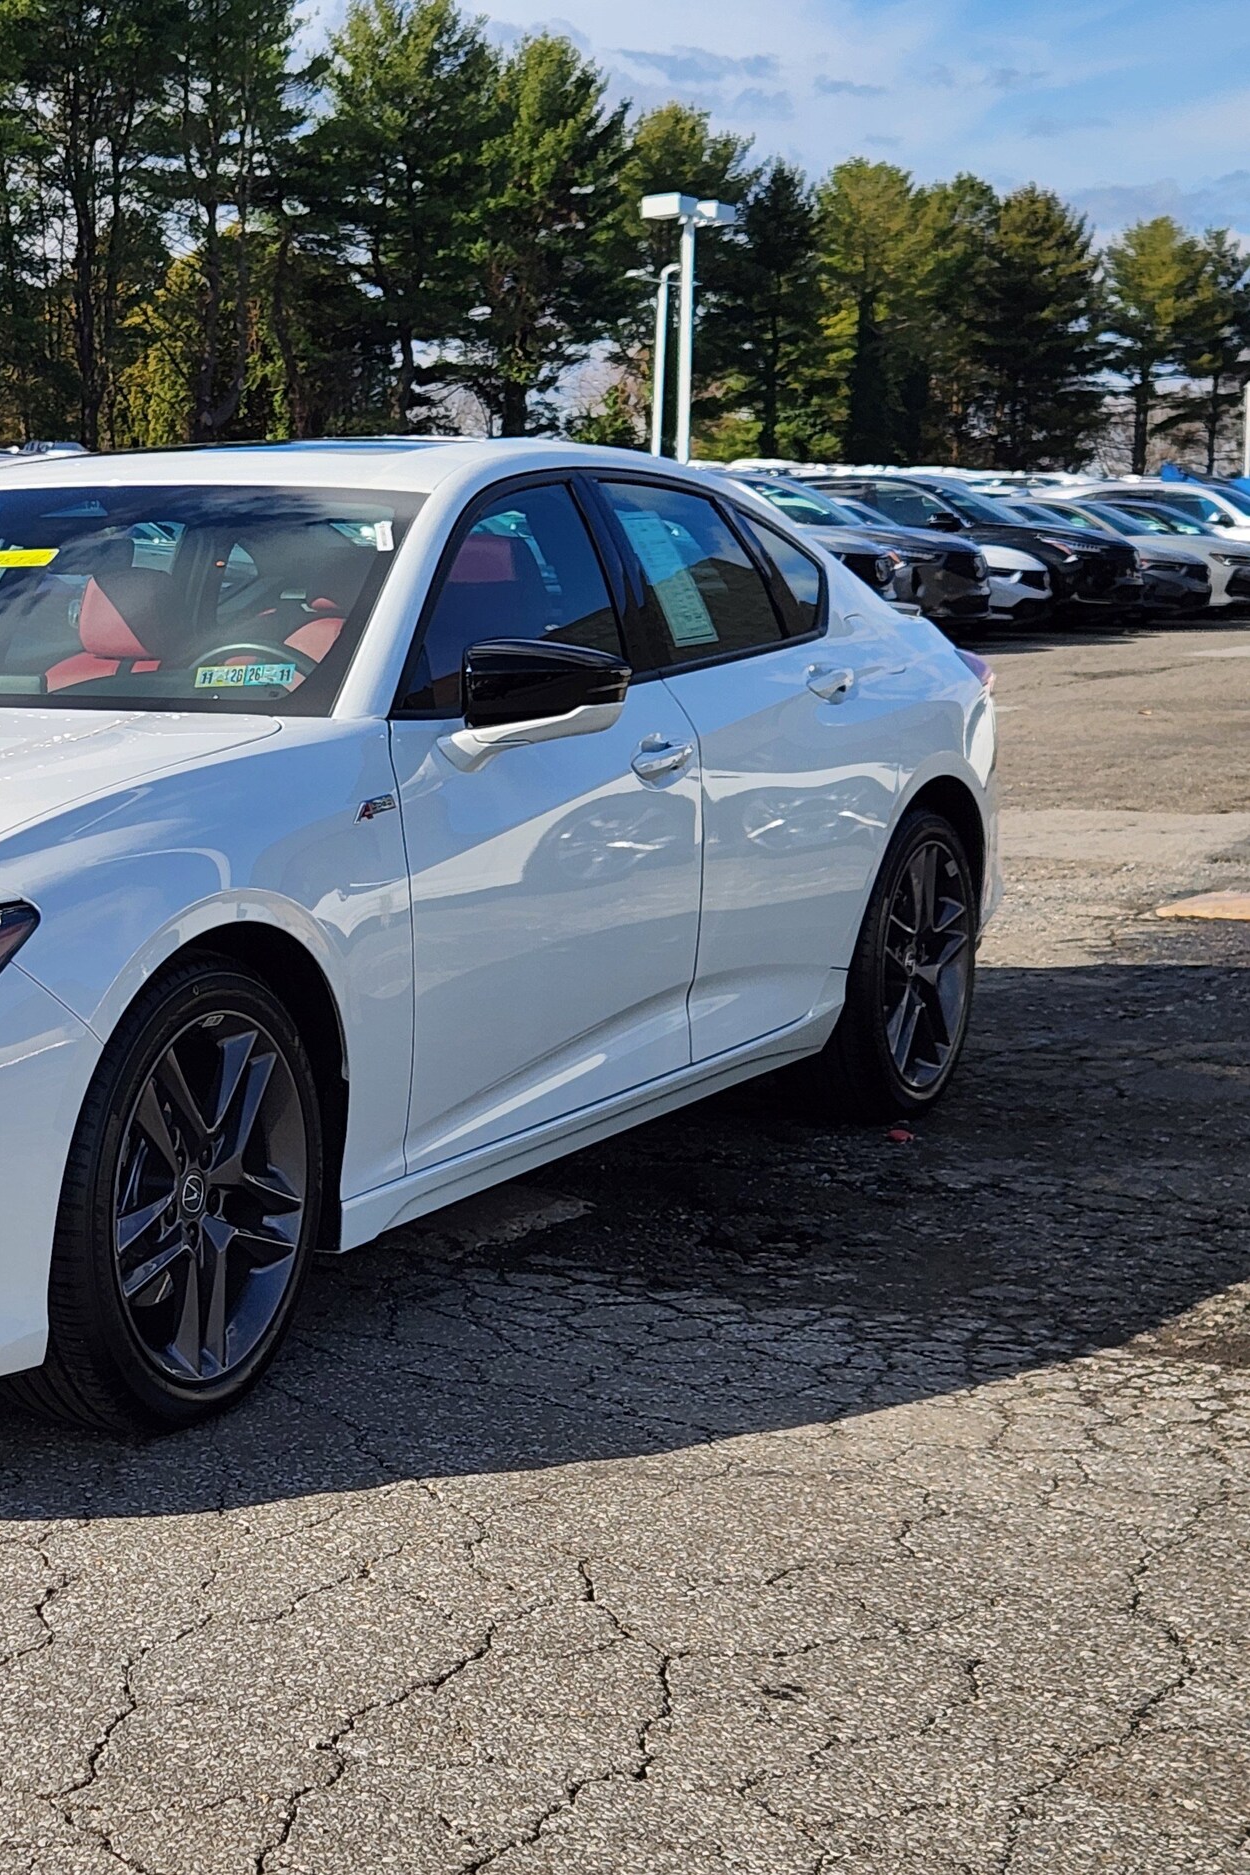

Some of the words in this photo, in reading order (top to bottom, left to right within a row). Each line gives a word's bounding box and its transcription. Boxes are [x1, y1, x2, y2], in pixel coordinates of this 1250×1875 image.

[202, 672, 214, 684] 11
[230, 668, 244, 683] 26
[249, 666, 261, 681] 26
[279, 668, 291, 681] 11
